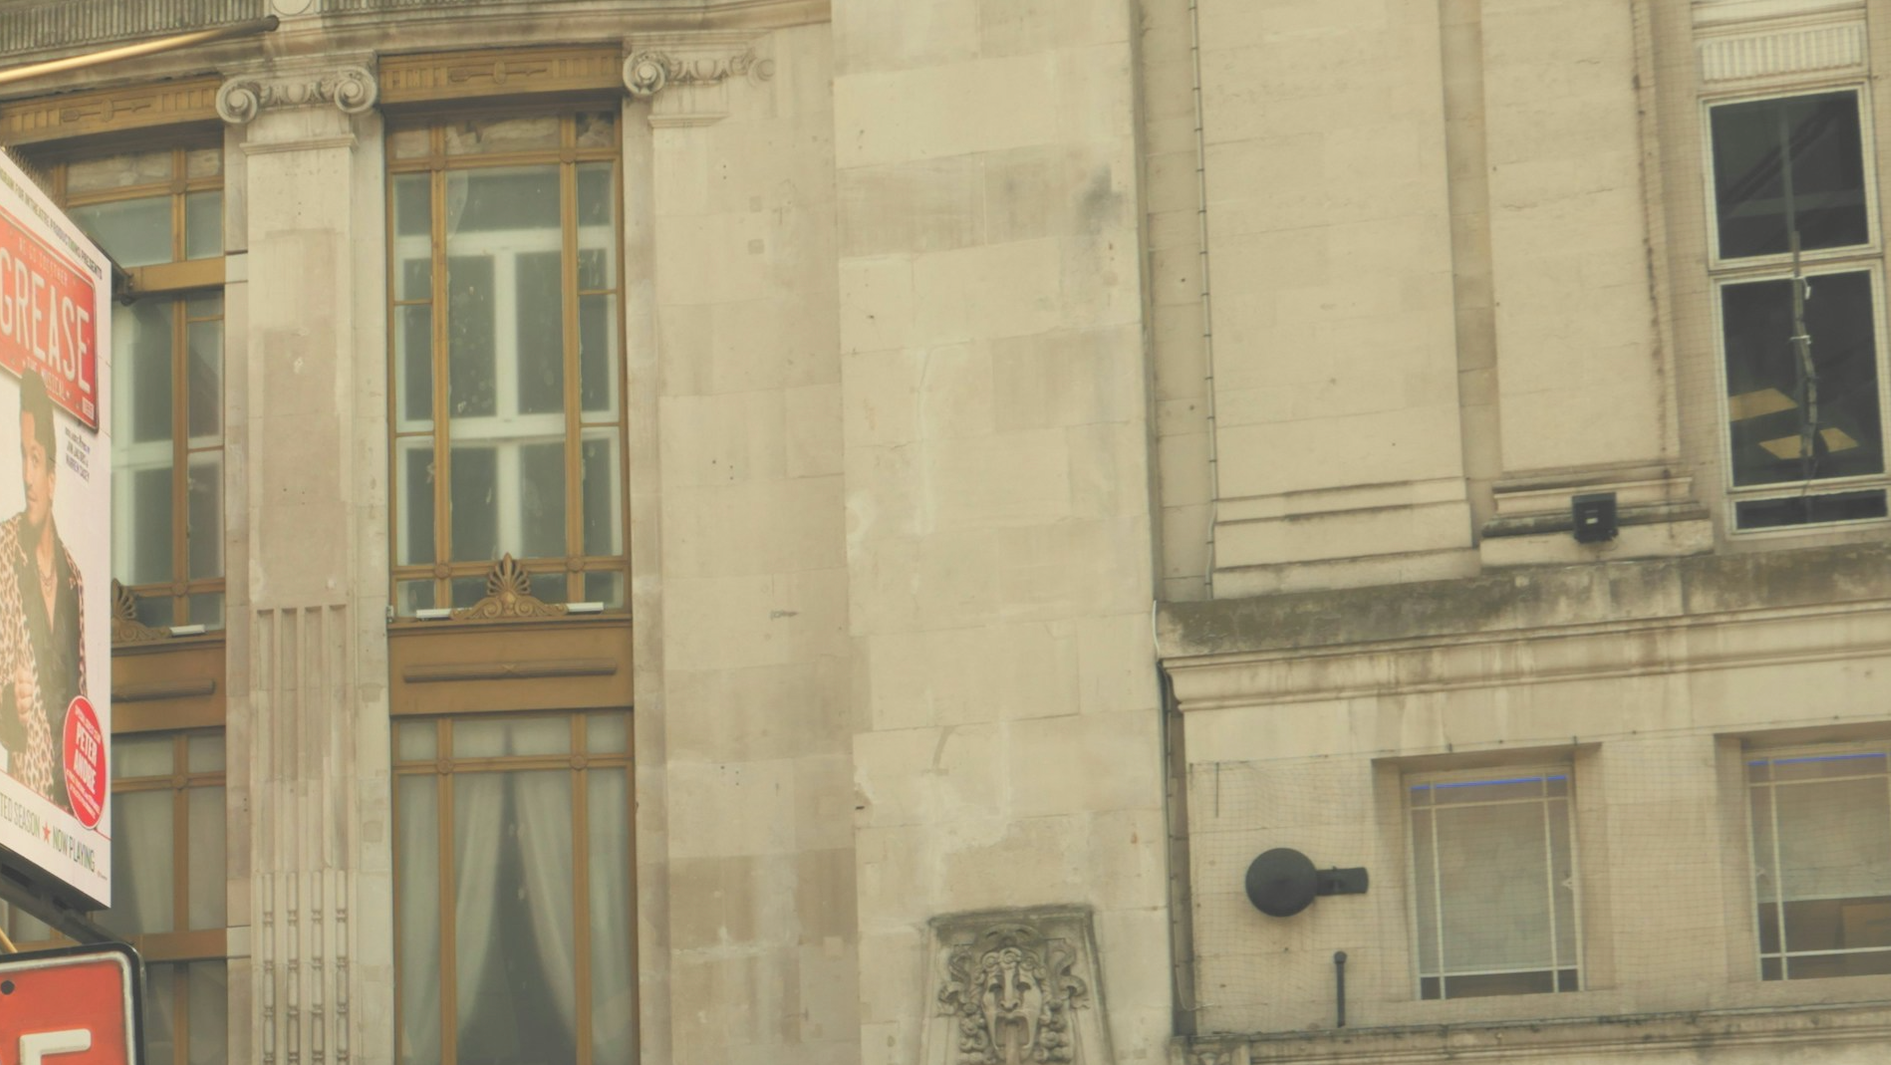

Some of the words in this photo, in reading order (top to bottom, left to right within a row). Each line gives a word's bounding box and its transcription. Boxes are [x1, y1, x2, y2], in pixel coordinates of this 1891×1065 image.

[14, 801, 40, 837] SEASON
[53, 826, 67, 854] NOW
[69, 835, 96, 873] PLAYING
